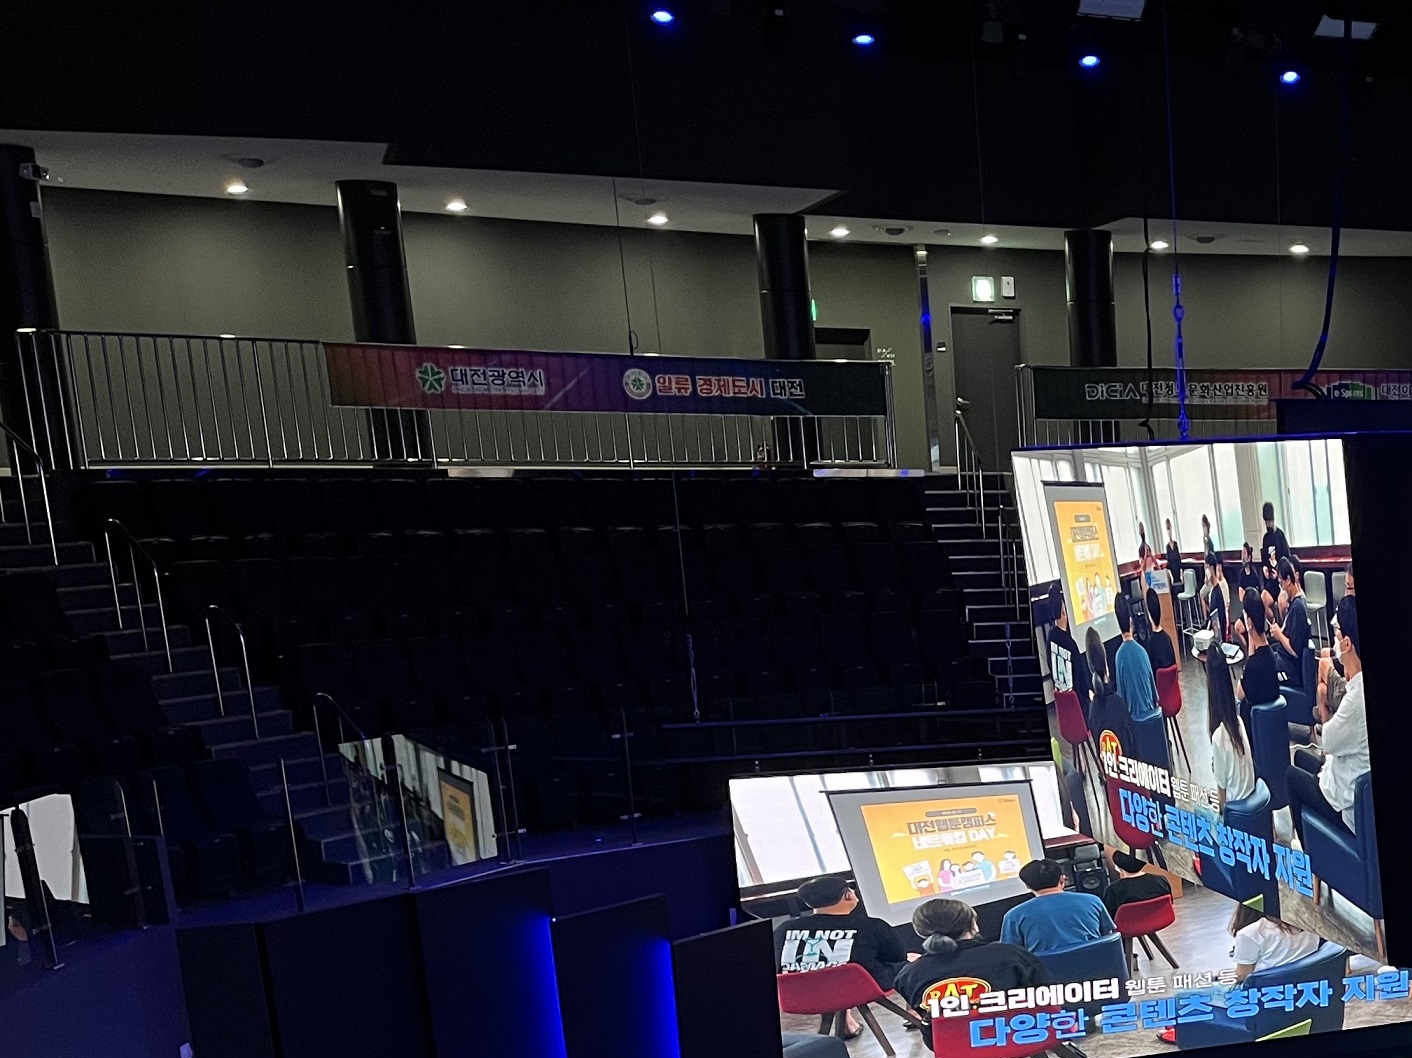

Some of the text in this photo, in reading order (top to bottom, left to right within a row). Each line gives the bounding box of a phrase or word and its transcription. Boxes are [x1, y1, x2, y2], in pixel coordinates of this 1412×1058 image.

[449, 367, 544, 387] 대전광역시
[656, 375, 805, 398] 일류 경제도시 대전
[1140, 381, 1268, 397] 전정문화산업진흥원
[1119, 755, 1172, 798] 크리에이터
[1171, 775, 1190, 803] 웹툰
[1209, 787, 1220, 813] 등
[969, 827, 996, 843] DAY
[1118, 788, 1314, 897] 다양한 콘텐츠 창작자 지원
[785, 929, 857, 941] IM NOT
[781, 939, 854, 962] IN
[927, 968, 1238, 1018] 1인 크리에이터 웹툰 패션 등
[969, 970, 1409, 1048] 다양한 콘텐츠 창작자 지원
